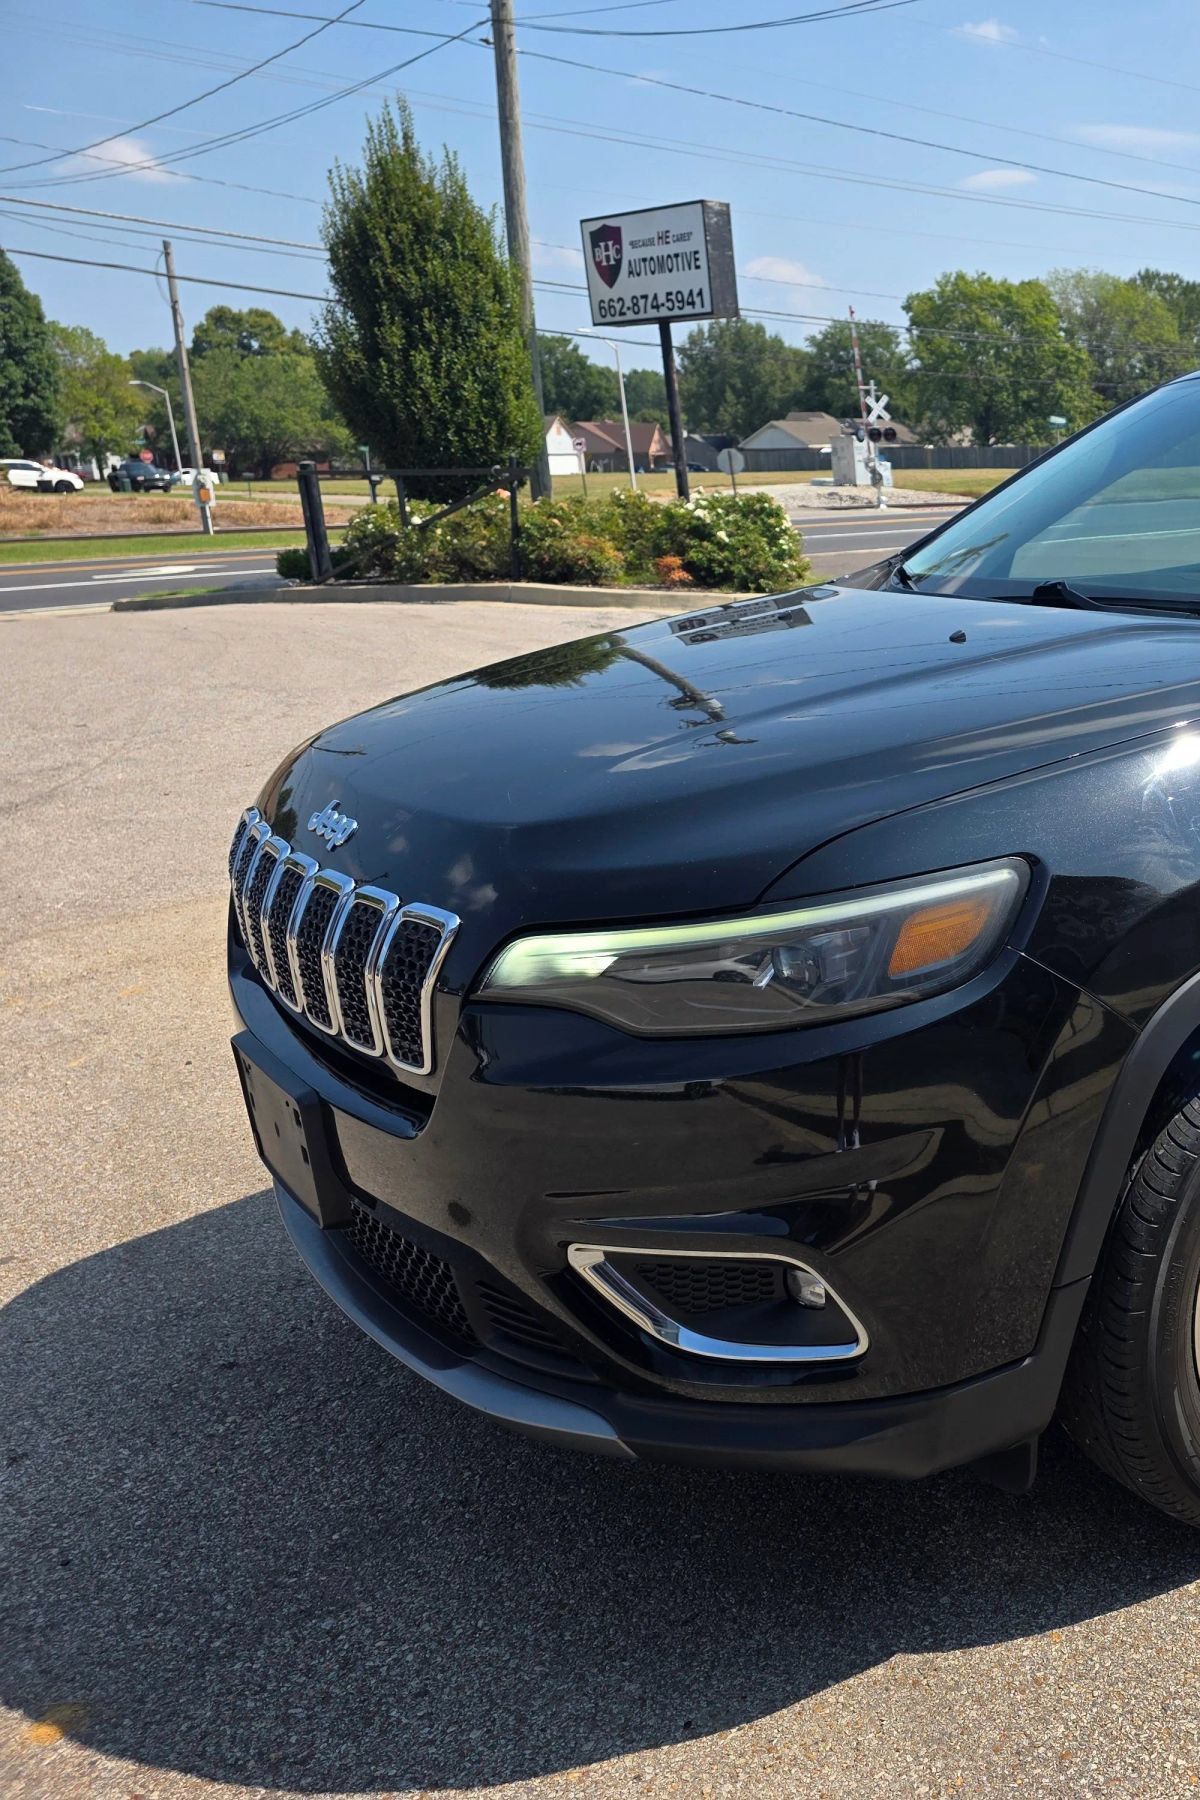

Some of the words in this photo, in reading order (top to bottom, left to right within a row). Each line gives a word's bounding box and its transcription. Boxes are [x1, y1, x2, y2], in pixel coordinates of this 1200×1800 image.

[656, 229, 671, 246] HE
[627, 250, 701, 278] AUTOMOTIVE
[598, 287, 705, 319] 662-874-5941
[307, 799, 358, 851] Jeep
